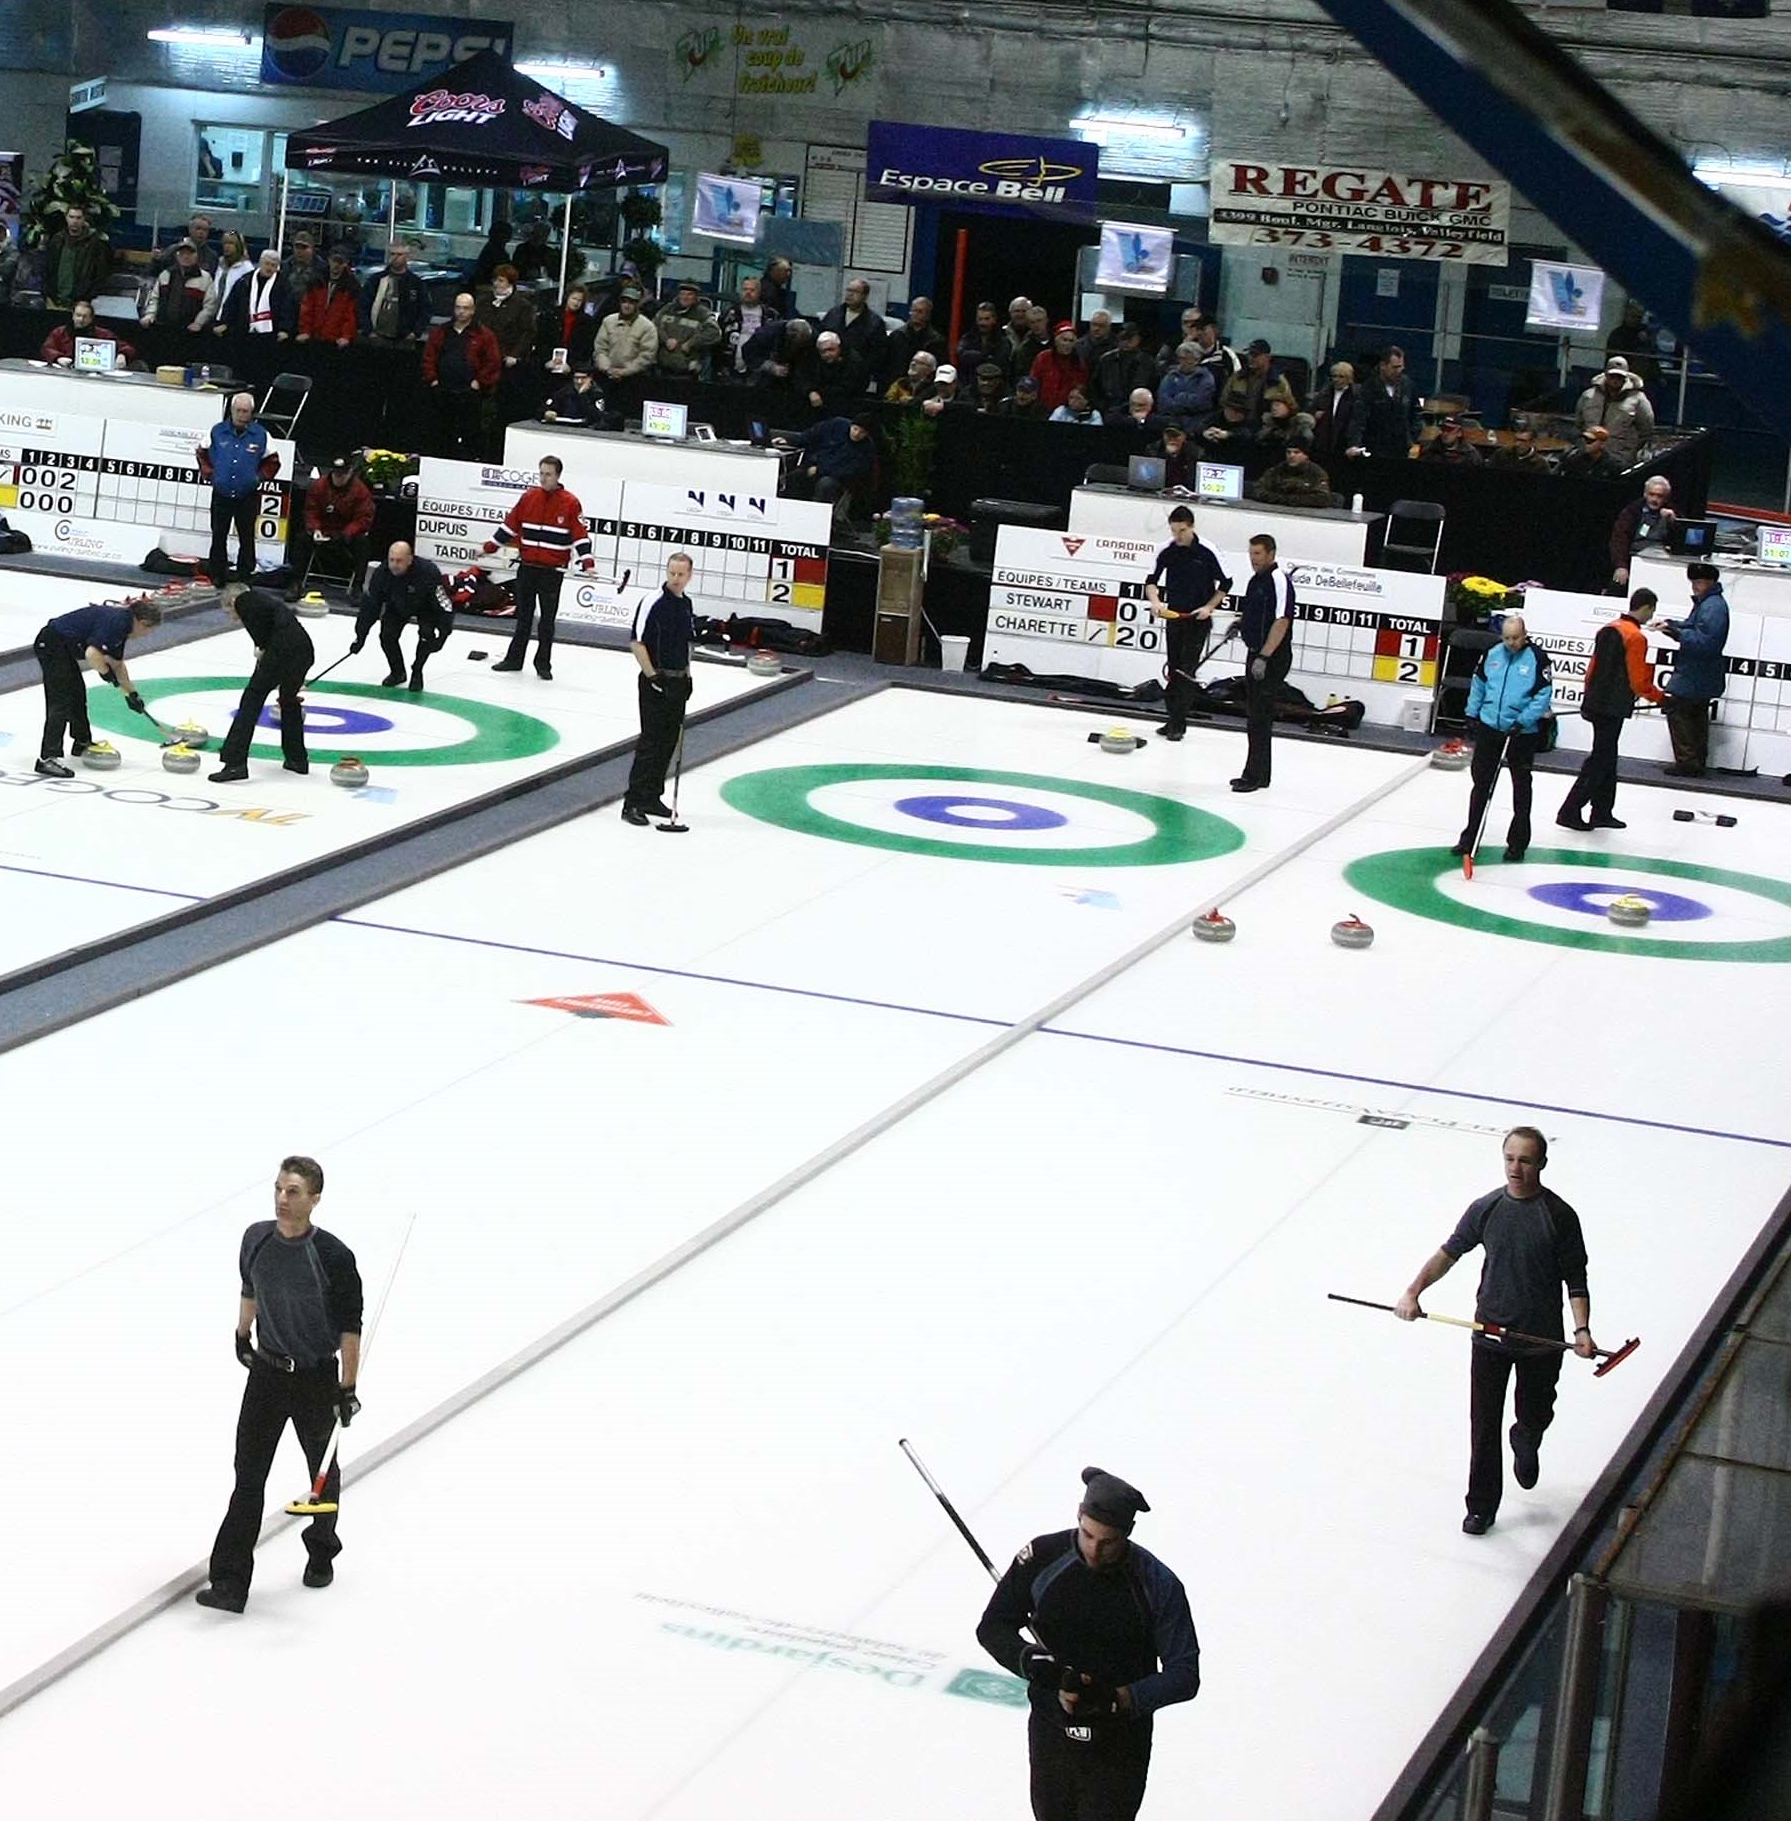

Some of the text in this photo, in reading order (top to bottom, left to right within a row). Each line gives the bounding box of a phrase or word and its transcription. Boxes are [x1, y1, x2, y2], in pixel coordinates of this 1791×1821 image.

[410, 90, 505, 116] Coors
[407, 108, 499, 127] LIGHT
[879, 169, 1066, 203] Espace Bell
[1229, 164, 1493, 213] REGATE
[1292, 201, 1493, 227] PONTIAC BUICK GMC
[1255, 228, 1464, 259] 373-4372
[1422, 226, 1503, 243] Valleyfield
[28, 451, 36, 464] 1
[47, 453, 56, 465] 2
[66, 456, 75, 468] 3
[85, 458, 94, 470] 4
[106, 460, 115, 472] 5
[126, 462, 135, 475] 6
[146, 465, 155, 477] 7
[165, 467, 174, 480] 8
[184, 469, 194, 482] 9
[263, 497, 279, 516] 2
[260, 520, 277, 538] 0
[418, 519, 468, 537] DUPUIS
[603, 520, 612, 534] 4
[626, 523, 635, 537] 5
[647, 526, 657, 539] 6
[668, 528, 678, 542] 7
[690, 531, 700, 545] 8
[712, 533, 721, 547] 9
[731, 536, 746, 550] 10
[753, 539, 766, 552] 11
[780, 543, 820, 559] TOTAL
[1096, 538, 1155, 553] CANADIAN
[1112, 551, 1137, 562] TIRE
[775, 560, 790, 579] 1
[772, 583, 791, 603] 2
[1062, 578, 1107, 594] TEAMS
[1127, 584, 1136, 598] 1
[1314, 607, 1324, 621] 9
[1334, 610, 1351, 624] 10
[1359, 612, 1374, 627] 11
[1388, 617, 1431, 635] TOTAL
[1006, 592, 1072, 612] STEWART
[1119, 602, 1138, 622] 0
[1404, 638, 1418, 657] 1
[995, 615, 1419, 684] CHARETTE 2 0 2
[1664, 651, 1674, 664] 1
[1738, 660, 1749, 674] 4
[1765, 662, 1776, 677] 5
[661, 1622, 925, 1687] Desjardins
